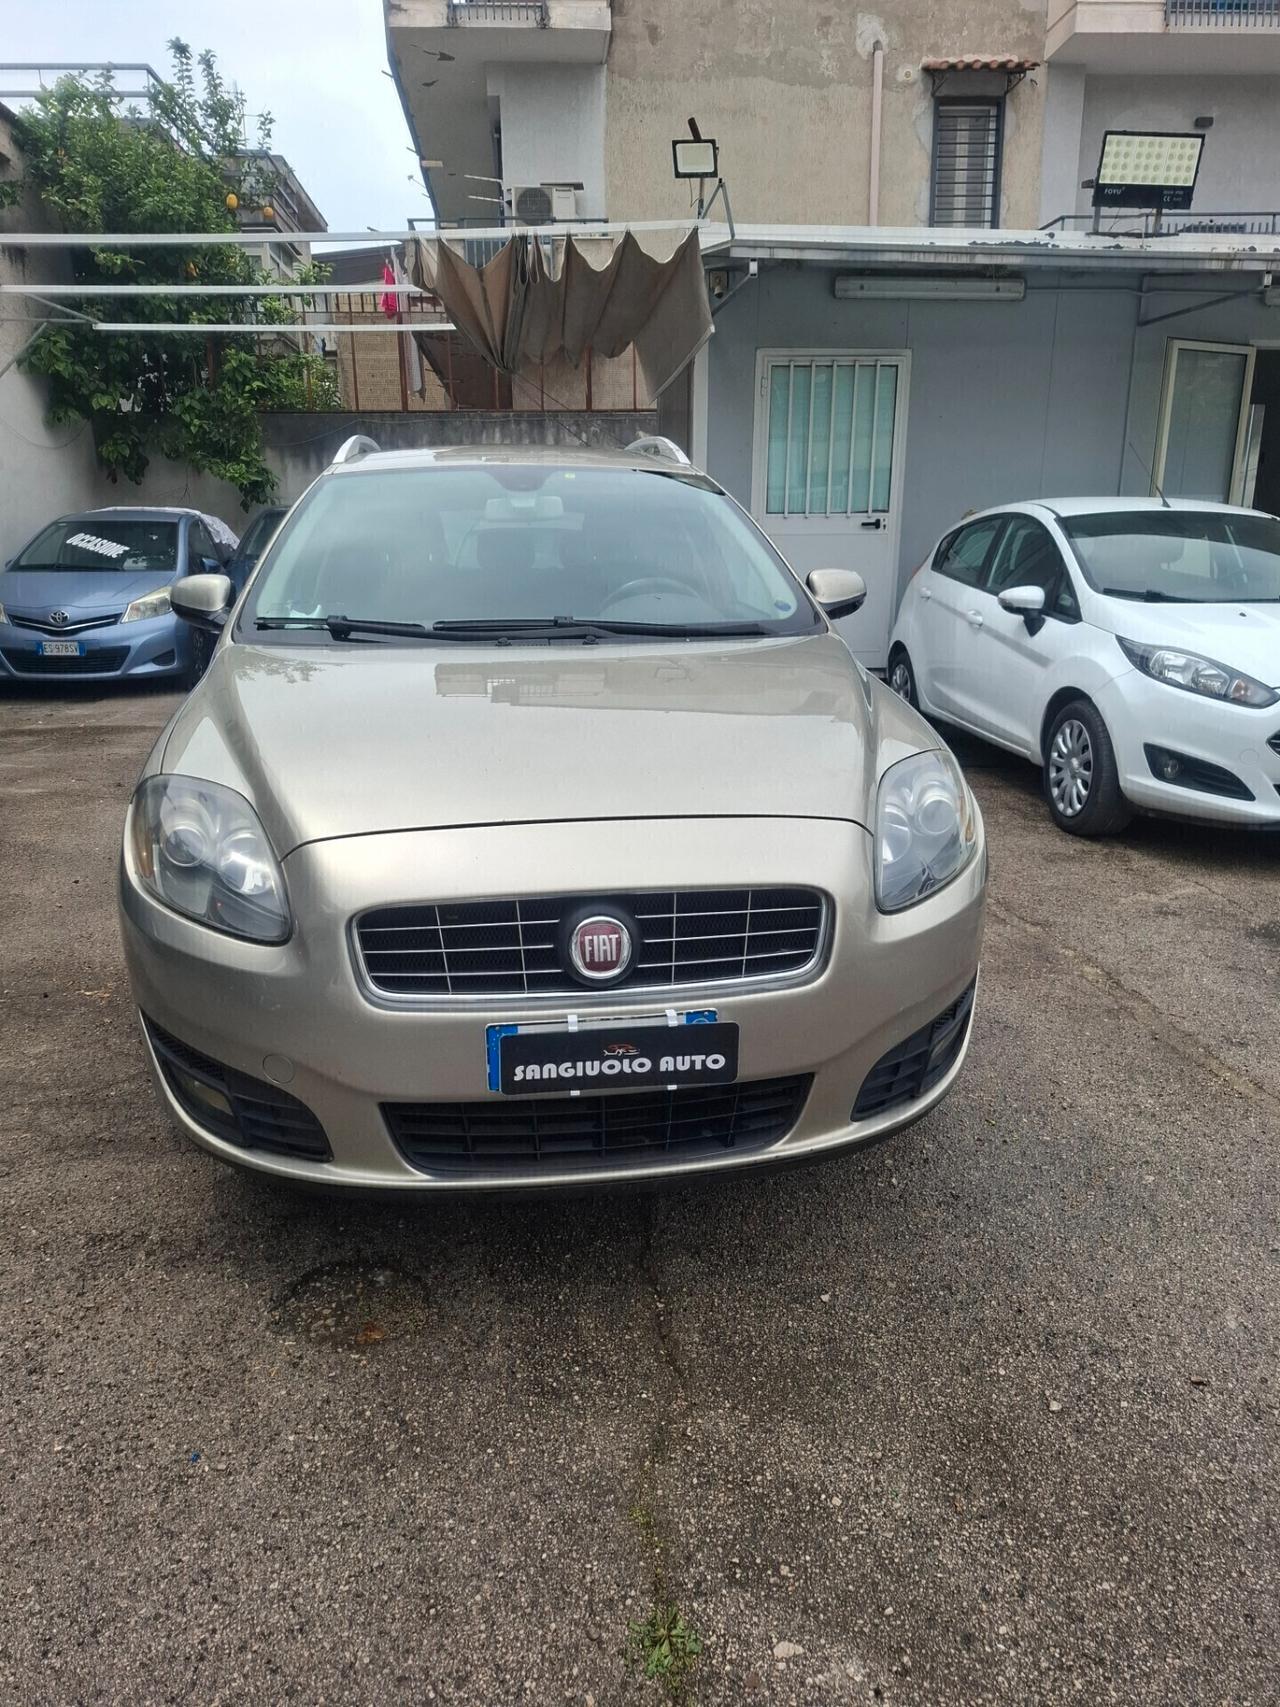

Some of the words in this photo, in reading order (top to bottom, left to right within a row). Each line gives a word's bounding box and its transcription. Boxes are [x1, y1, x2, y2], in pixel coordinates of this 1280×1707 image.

[66, 533, 130, 558] OCCASIONE
[584, 934, 619, 962] FIAT
[513, 1057, 652, 1081] SANGIUOLO
[659, 1053, 726, 1072] AUTO
